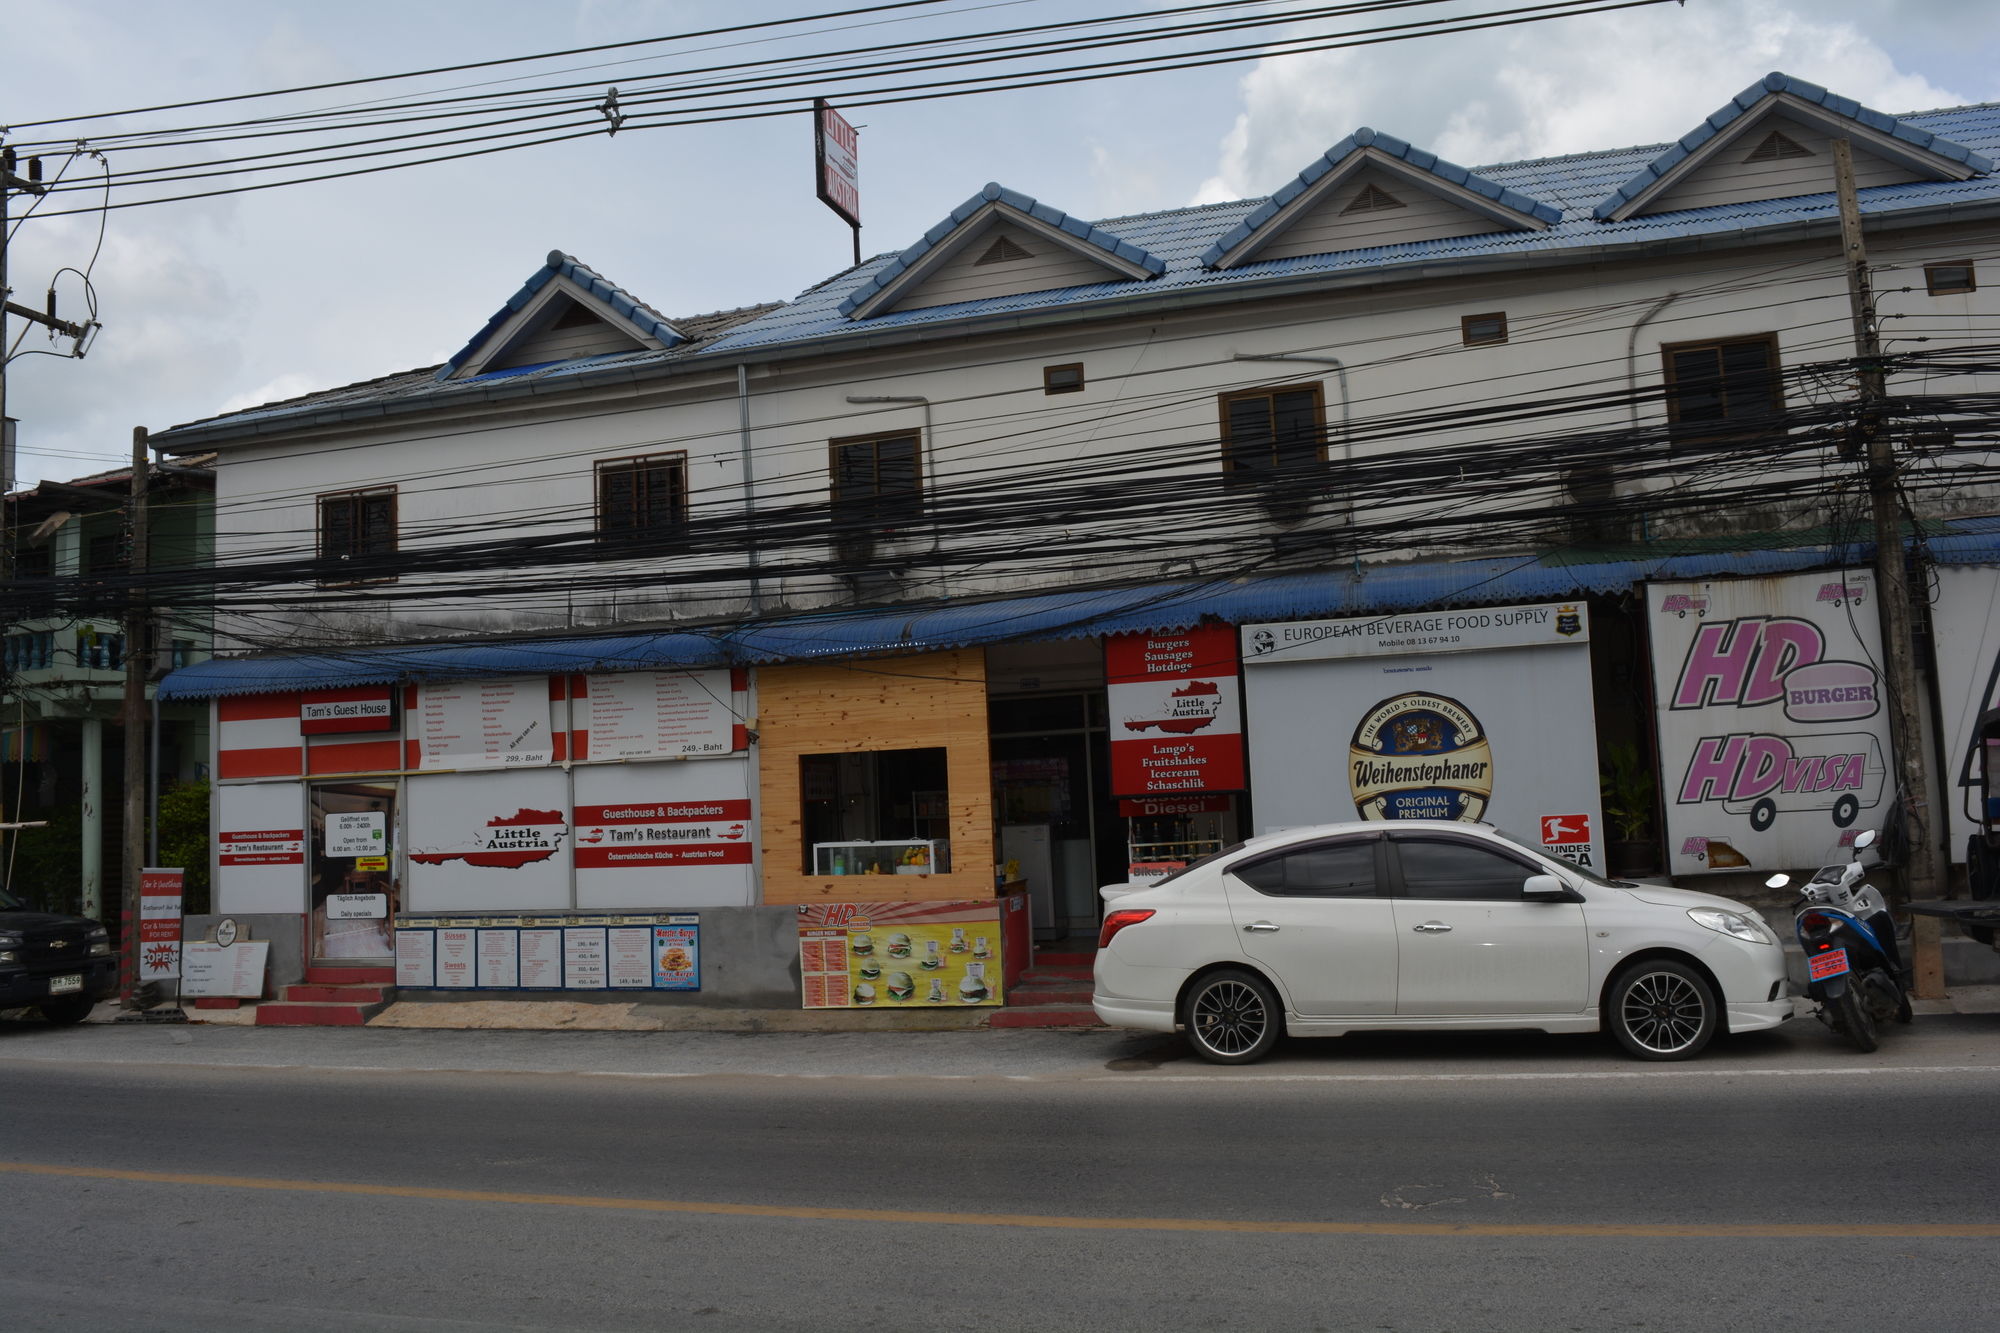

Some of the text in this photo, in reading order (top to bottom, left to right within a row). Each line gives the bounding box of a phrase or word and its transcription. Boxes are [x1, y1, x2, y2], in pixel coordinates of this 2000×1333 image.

[825, 109, 856, 156] LITTLE
[828, 167, 858, 218] AUSTRIA
[1284, 624, 1362, 641] EUROPEAN
[1367, 618, 1443, 635] BEVERAGE
[1448, 615, 1490, 630] FOOD
[1495, 610, 1549, 626] SUPPLY
[1147, 640, 1190, 651] Burgers
[1379, 637, 1404, 647] Mobile
[1418, 637, 1426, 645] 13
[1428, 636, 1438, 644] 67
[1144, 651, 1193, 662] Sausages
[1147, 662, 1193, 673] Hotdogs
[1670, 615, 1873, 711] HD BURGER
[1176, 698, 1205, 708] Little
[307, 703, 387, 718] Tam's Guest House
[1172, 706, 1210, 717] Austria
[1364, 726, 1377, 739] THE
[1410, 699, 1441, 709] OLDEST
[1442, 705, 1473, 735] BREWERY
[703, 743, 723, 751] Baht
[1153, 743, 1195, 756] Lango's
[525, 754, 543, 762] Baht
[1142, 755, 1207, 768] Fruitshakes
[1151, 769, 1200, 779] Icecream
[1353, 758, 1488, 788] Weihenstephaner
[1676, 732, 1867, 805] HD VISA
[1147, 778, 1205, 791] Schaschlik
[1144, 800, 1205, 815] Diesel
[1395, 795, 1451, 808] ORIGINAL
[602, 805, 724, 819] Guesthouse & Backpackers
[1398, 807, 1448, 819] PREMIUM
[494, 828, 541, 839] Little
[609, 826, 711, 842] Tam's Restaurant
[252, 843, 284, 851] Restaurant
[486, 838, 549, 849] Austria
[608, 853, 654, 861] Österreichische
[681, 851, 707, 859] Austrian
[708, 850, 724, 858] Food
[1133, 867, 1163, 877] Bikes
[821, 903, 858, 928] HD
[147, 952, 179, 962] OPEN
